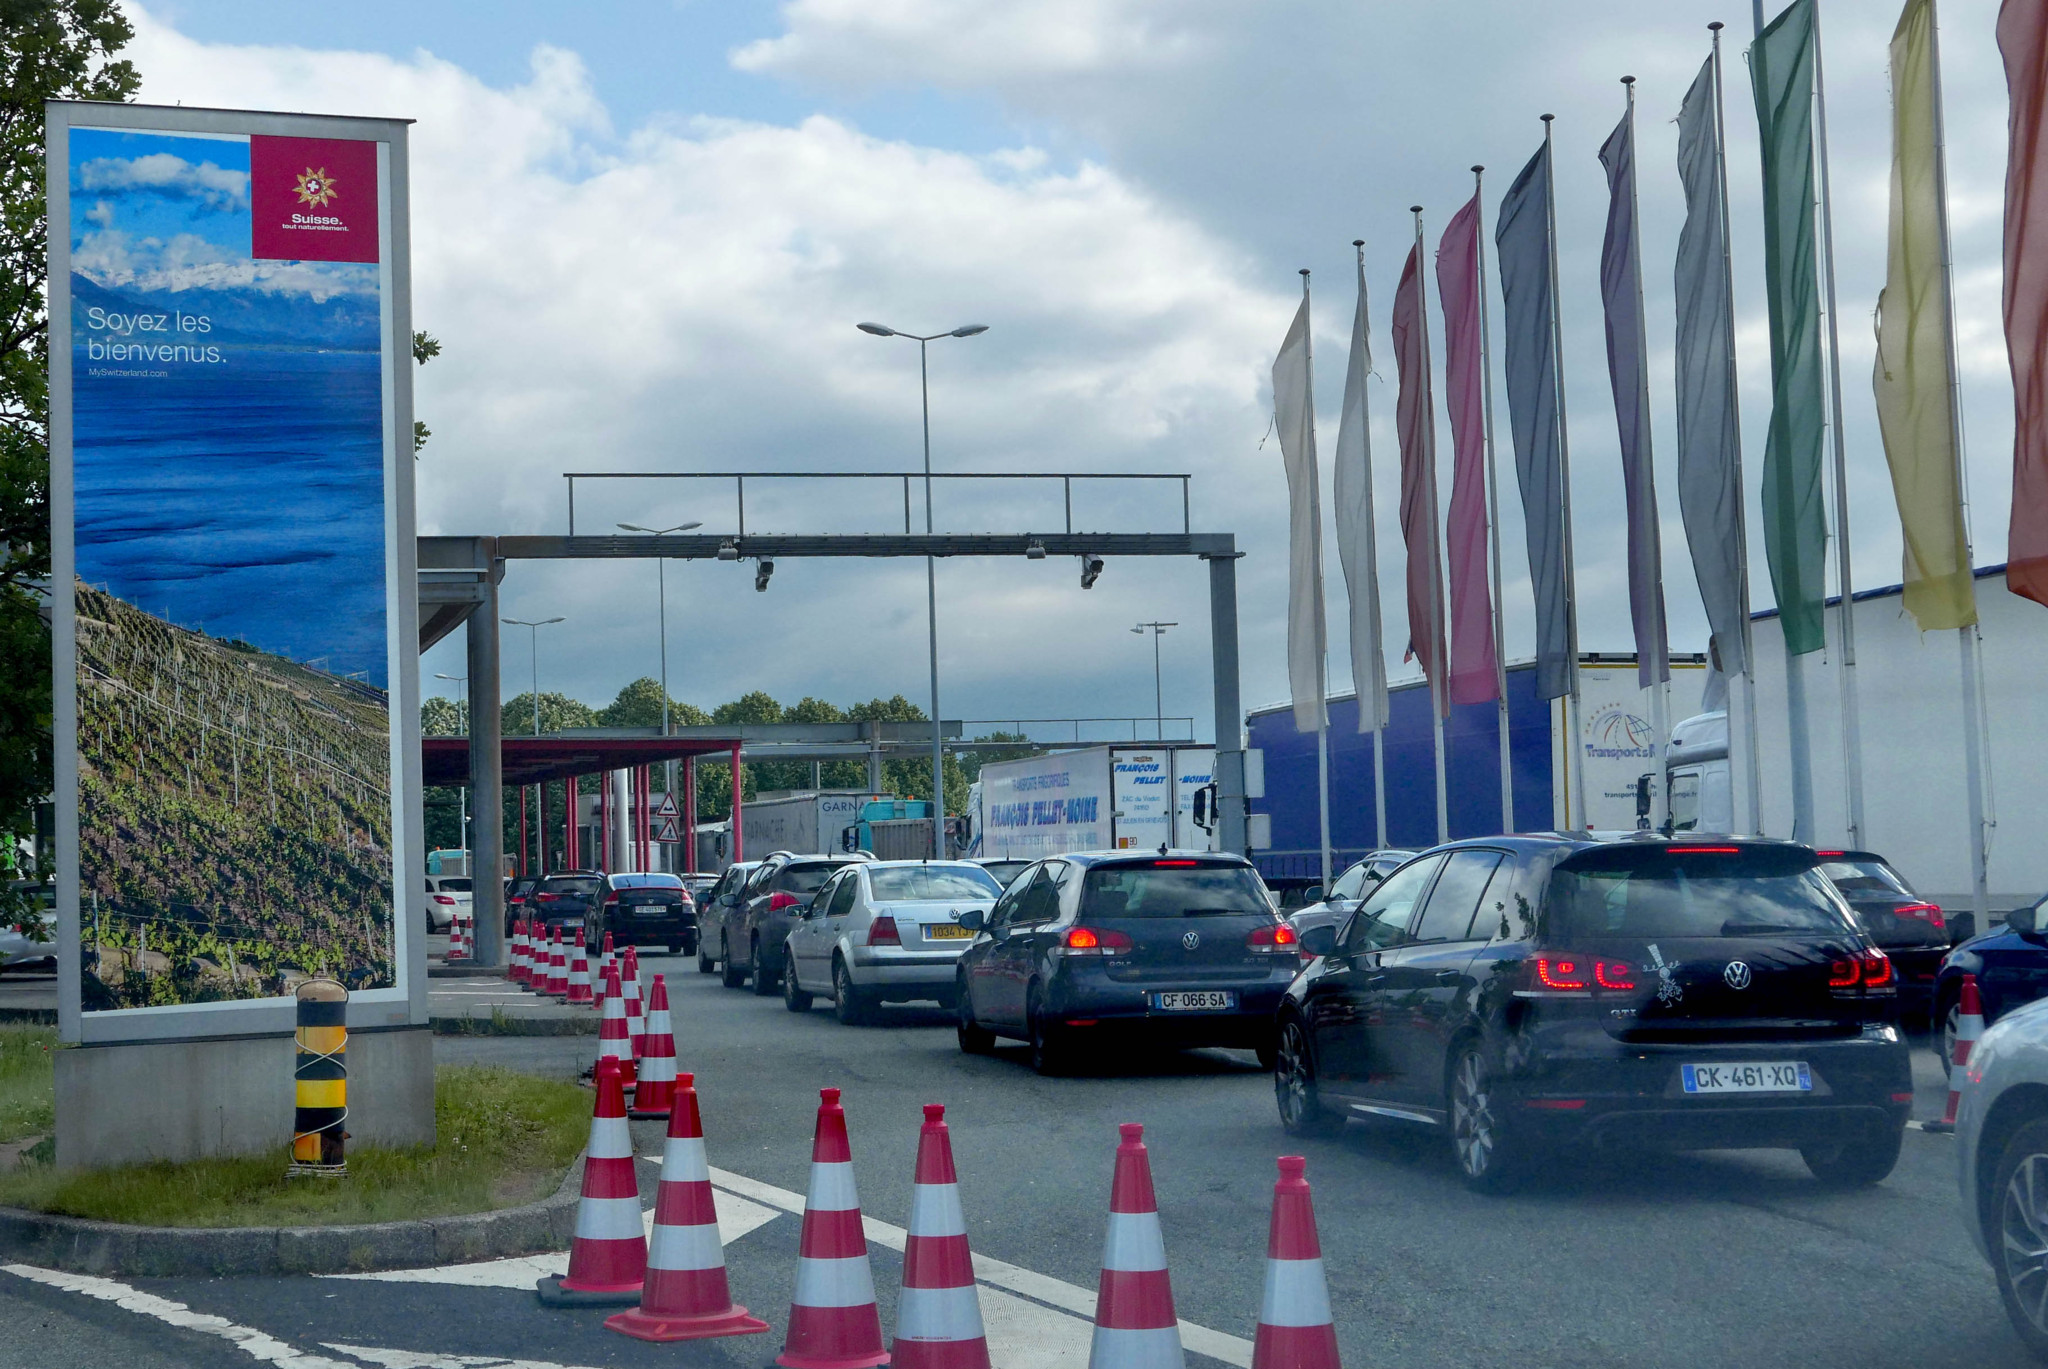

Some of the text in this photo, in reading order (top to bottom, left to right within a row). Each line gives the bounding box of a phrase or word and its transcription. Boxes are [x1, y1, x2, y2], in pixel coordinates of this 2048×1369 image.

[292, 213, 343, 225] Suisse.
[88, 307, 211, 336] Soyez les
[89, 338, 227, 363] bienvenus.
[89, 368, 168, 379] MySwitzerland.com
[1585, 744, 1649, 760] Transports
[1115, 763, 1160, 773] FRANÇOIS
[1133, 776, 1167, 785] PELLET
[932, 926, 956, 939] 1034
